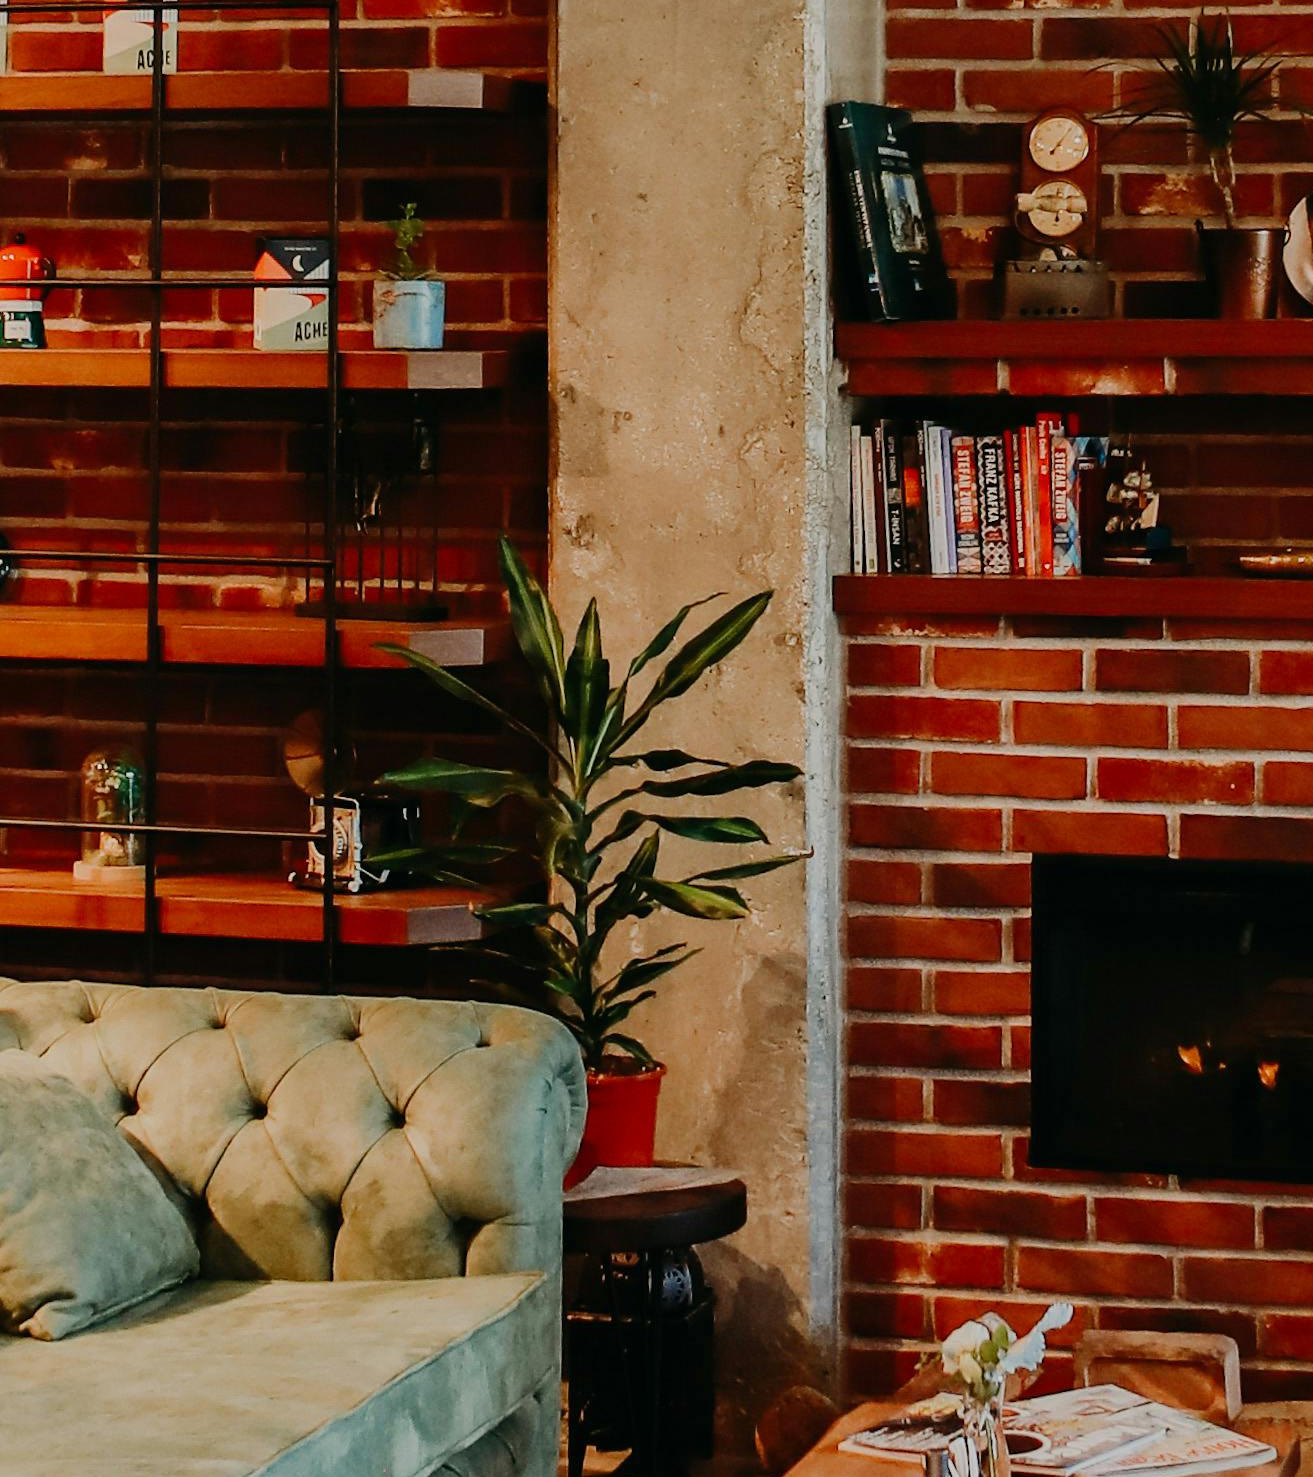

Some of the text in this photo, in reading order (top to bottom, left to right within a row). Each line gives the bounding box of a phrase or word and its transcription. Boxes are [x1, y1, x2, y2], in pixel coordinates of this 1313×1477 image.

[957, 449, 974, 523] STEFAN ZWEIG
[984, 448, 1000, 523] FRANZ KAFKA
[1054, 452, 1067, 520] STEFAN ZWEIG
